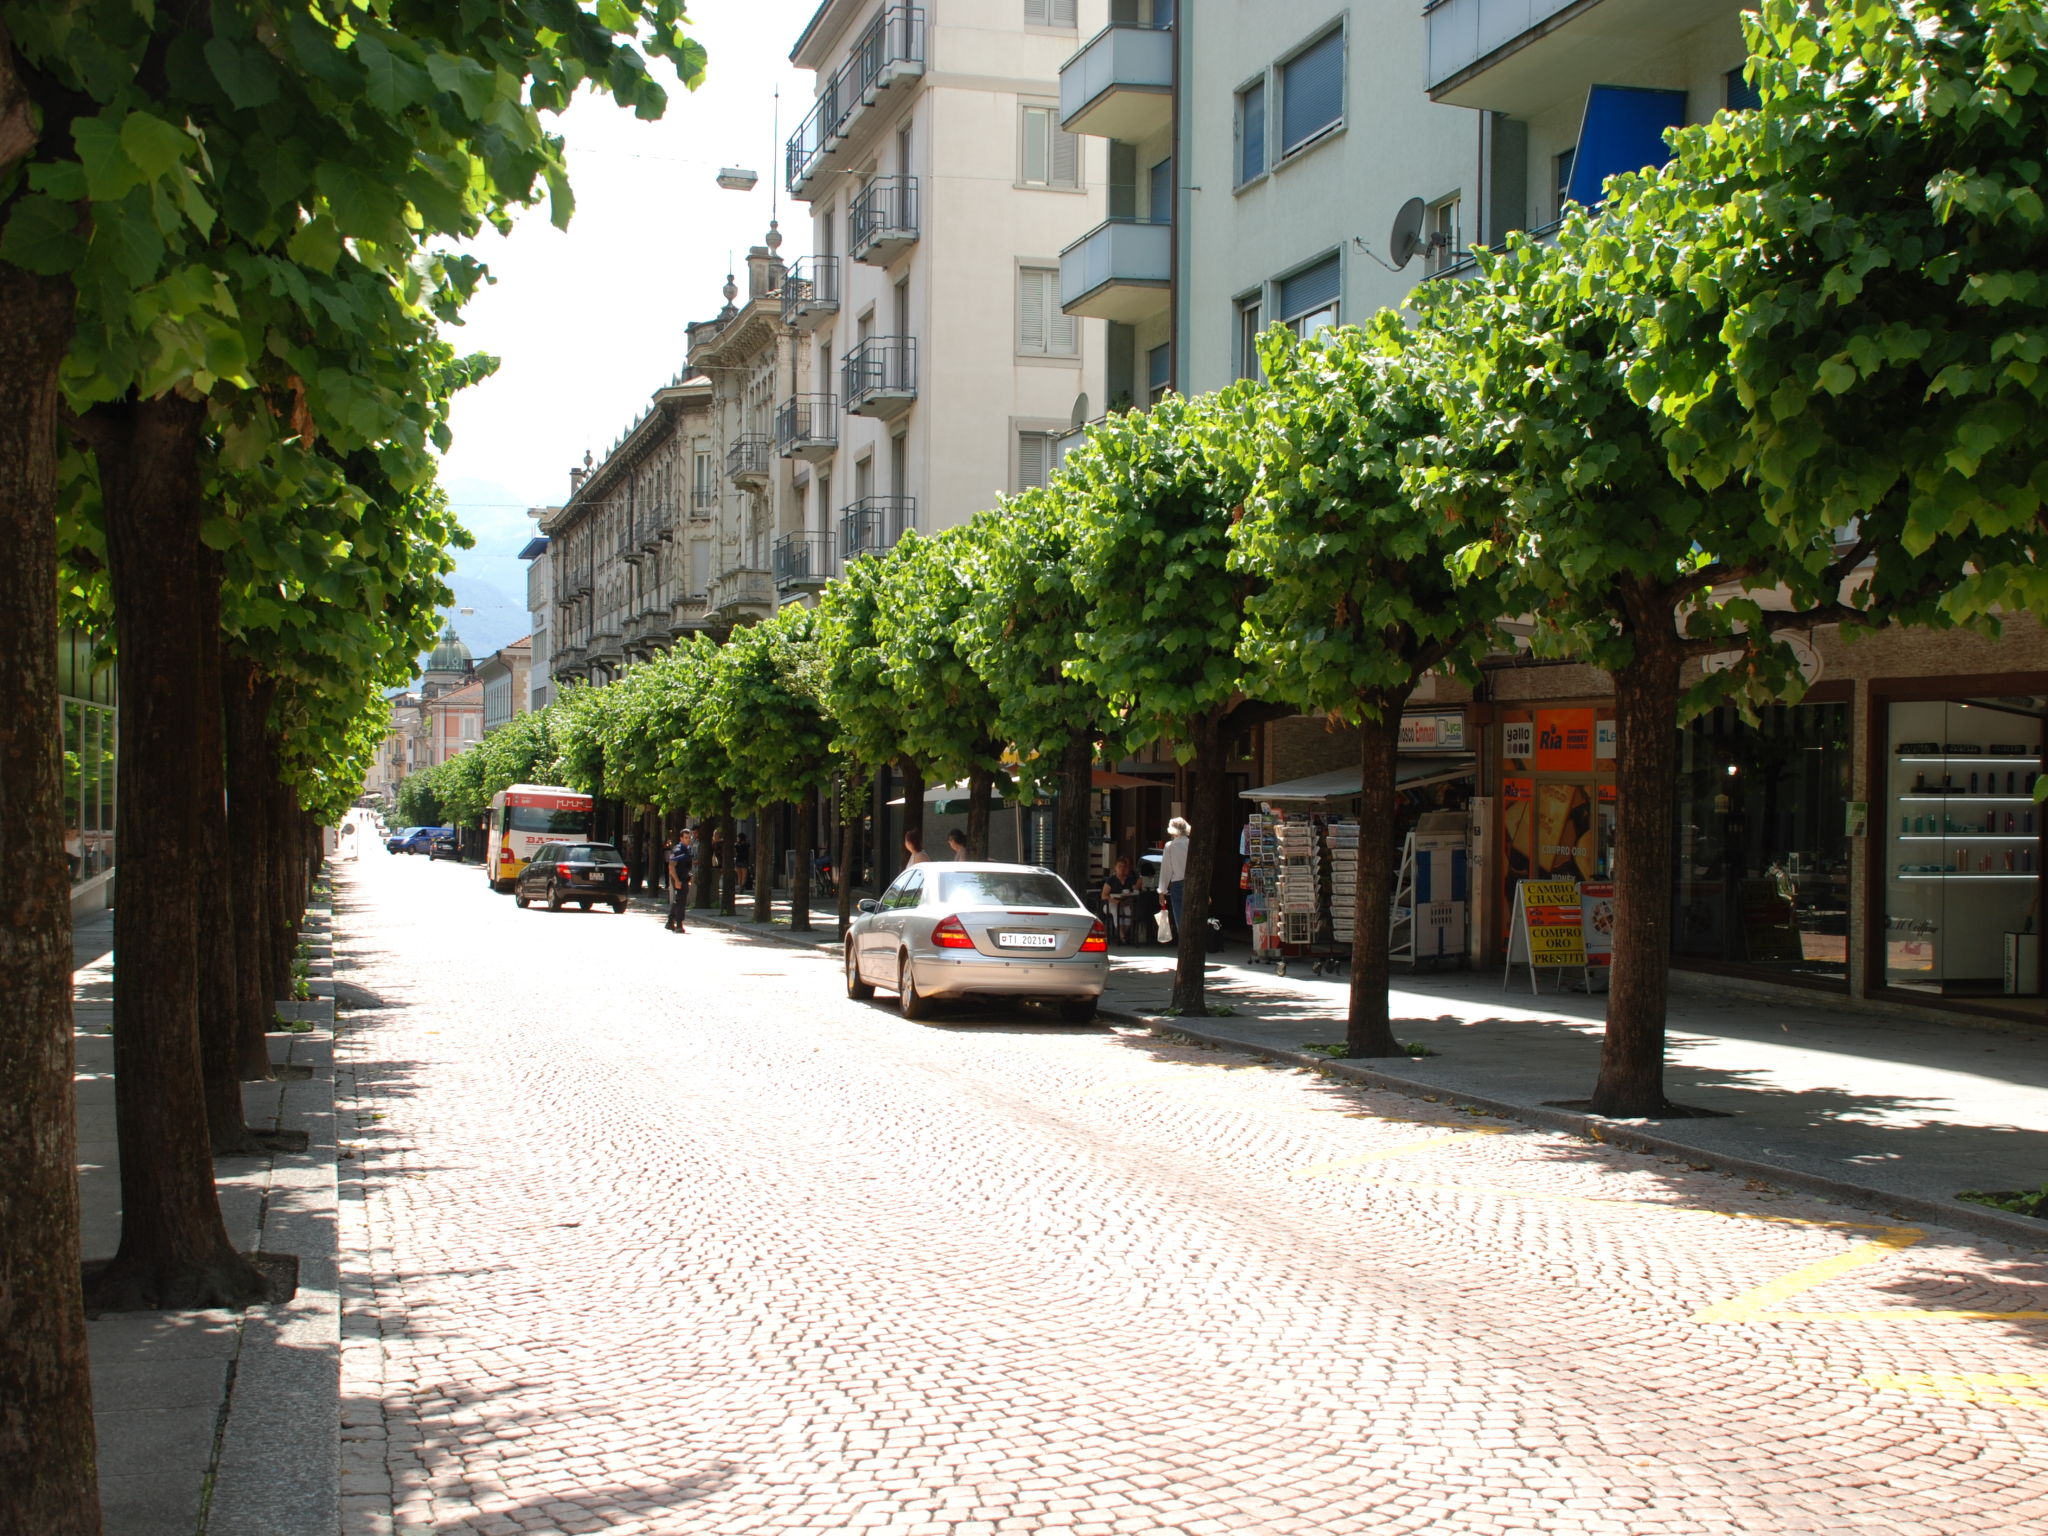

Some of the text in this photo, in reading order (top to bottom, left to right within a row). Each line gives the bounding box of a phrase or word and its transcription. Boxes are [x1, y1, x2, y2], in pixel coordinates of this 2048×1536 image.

[1507, 728, 1530, 742] yallo
[1540, 724, 1563, 750] Ria
[1542, 845, 1587, 856] COMPRO ORO
[1527, 884, 1575, 894] CAMBIO
[1528, 893, 1578, 904] CHANGE
[1532, 927, 1582, 938] COMPRO
[1008, 933, 1047, 945] TI 20216
[1546, 938, 1572, 948] ORO
[1535, 952, 1585, 964] PRESTITI
